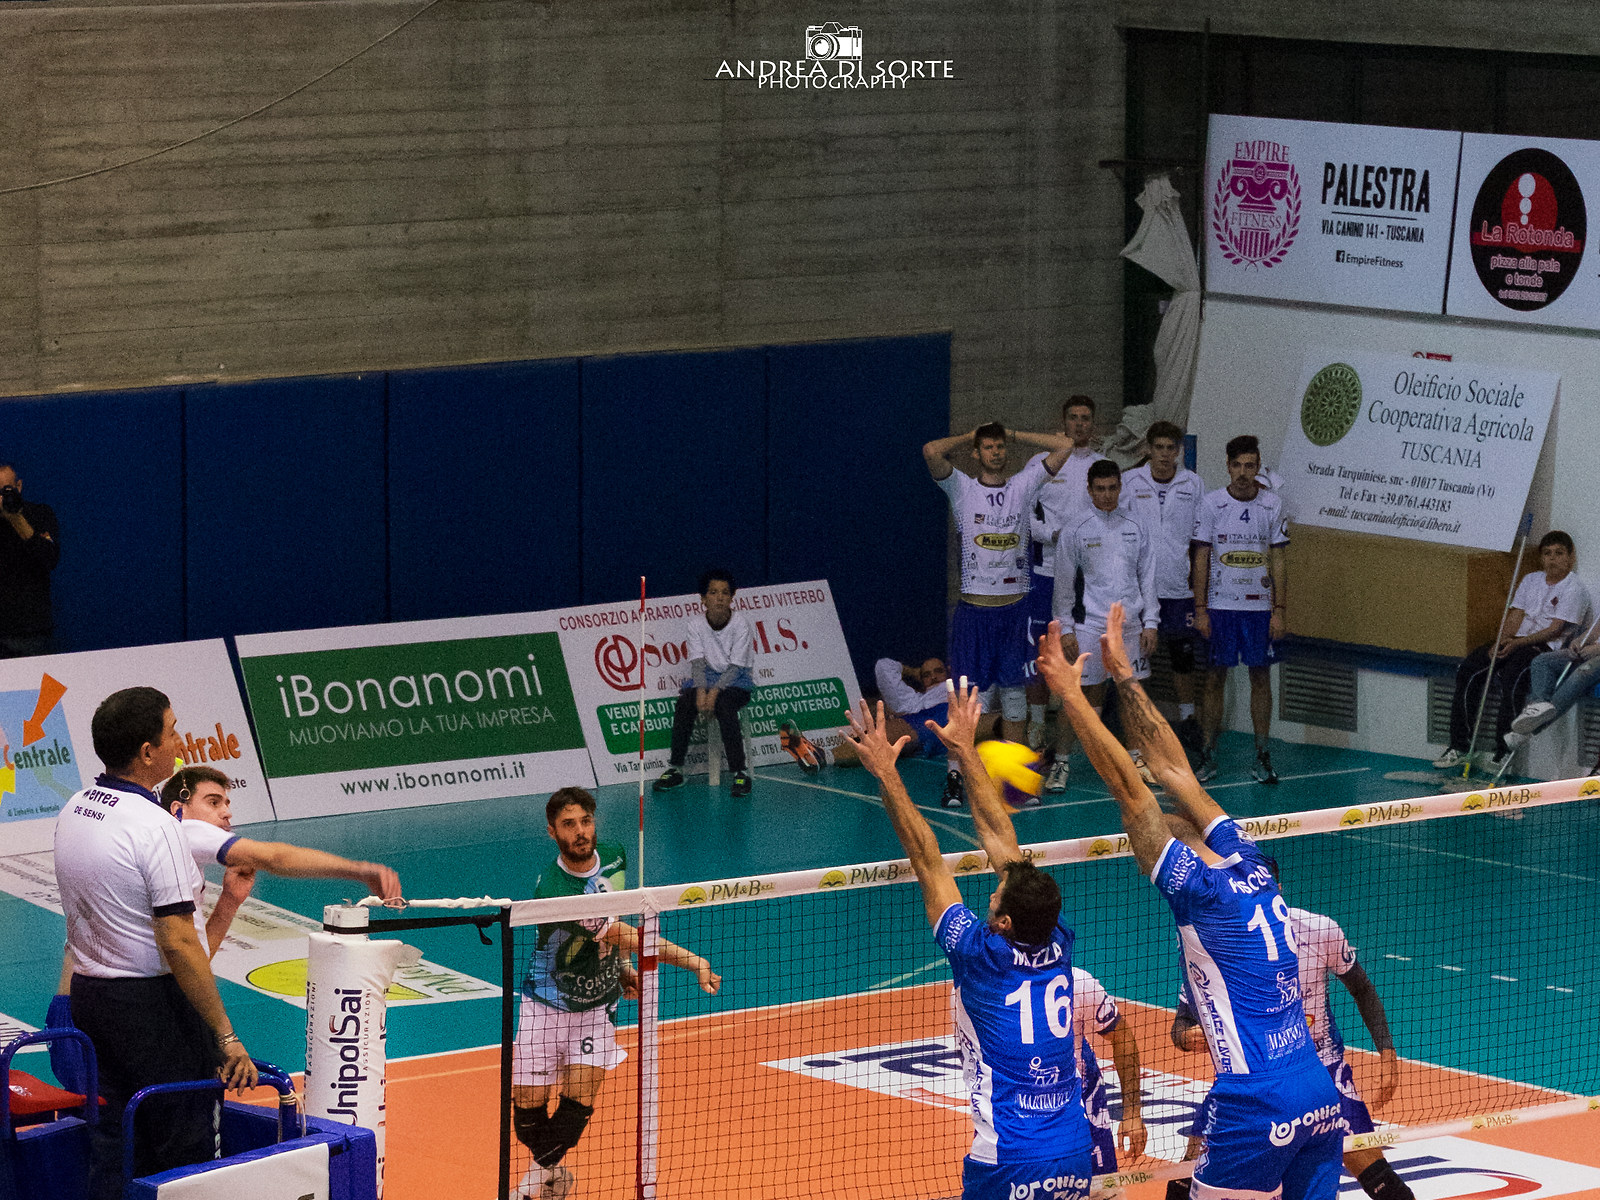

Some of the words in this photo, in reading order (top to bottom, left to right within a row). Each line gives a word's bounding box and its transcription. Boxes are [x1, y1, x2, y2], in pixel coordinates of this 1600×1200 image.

[1234, 140, 1290, 162] EMPIRE
[1321, 162, 1430, 213] PALESTRA
[1231, 211, 1282, 229] FITNESS
[1321, 219, 1334, 235] VIA
[1336, 221, 1364, 238] CANINO
[1366, 223, 1379, 239] 141
[1386, 224, 1425, 243] TUSCANIA
[1482, 220, 1502, 242] La
[1508, 224, 1574, 248] Rotonda
[1346, 252, 1404, 268] EmpireFitness
[1490, 254, 1518, 270] pizza
[1518, 256, 1537, 271] alla
[1394, 371, 1461, 400] Oleificio
[1465, 379, 1525, 409] Sociale
[1368, 400, 1462, 433] Cooperativa
[1464, 413, 1534, 443] Agricola
[1400, 441, 1482, 469] TUSCANIA
[1306, 463, 1335, 477] Strada
[1389, 477, 1403, 486] snc
[1410, 475, 1437, 489] 01017
[1438, 479, 1475, 496] Tuscania
[986, 491, 1005, 507] 10
[1340, 486, 1352, 500] Tel
[1360, 489, 1376, 503] Fax
[1239, 508, 1251, 524] 4
[559, 609, 629, 631] CONSORZIO
[763, 593, 776, 608] DI
[777, 589, 826, 608] VITERBO
[758, 668, 775, 679] snc
[1132, 657, 1149, 673] 12
[277, 653, 543, 718] iBonanomi
[610, 723, 620, 736] E
[766, 703, 789, 716] CAP
[790, 696, 841, 714] VITERBO
[656, 700, 670, 715] DI
[288, 718, 405, 747] MUOVIAMO
[409, 717, 431, 737] LA
[435, 713, 472, 733] TUA
[477, 705, 556, 729] IMPRESA
[339, 761, 526, 796] www.ibonanomi.it
[614, 763, 628, 774] Via
[1487, 788, 1530, 808] PM&B
[73, 805, 82, 815] DE
[83, 808, 106, 822] SENSI
[1367, 803, 1410, 823] PM&B
[850, 864, 899, 885] PM&B
[710, 880, 761, 902] PM&B
[1005, 974, 1073, 1045] 16
[307, 981, 317, 1067] ASSICURAZIONI
[362, 987, 372, 1072] ASSICURAZIONI
[580, 1036, 594, 1055] 6
